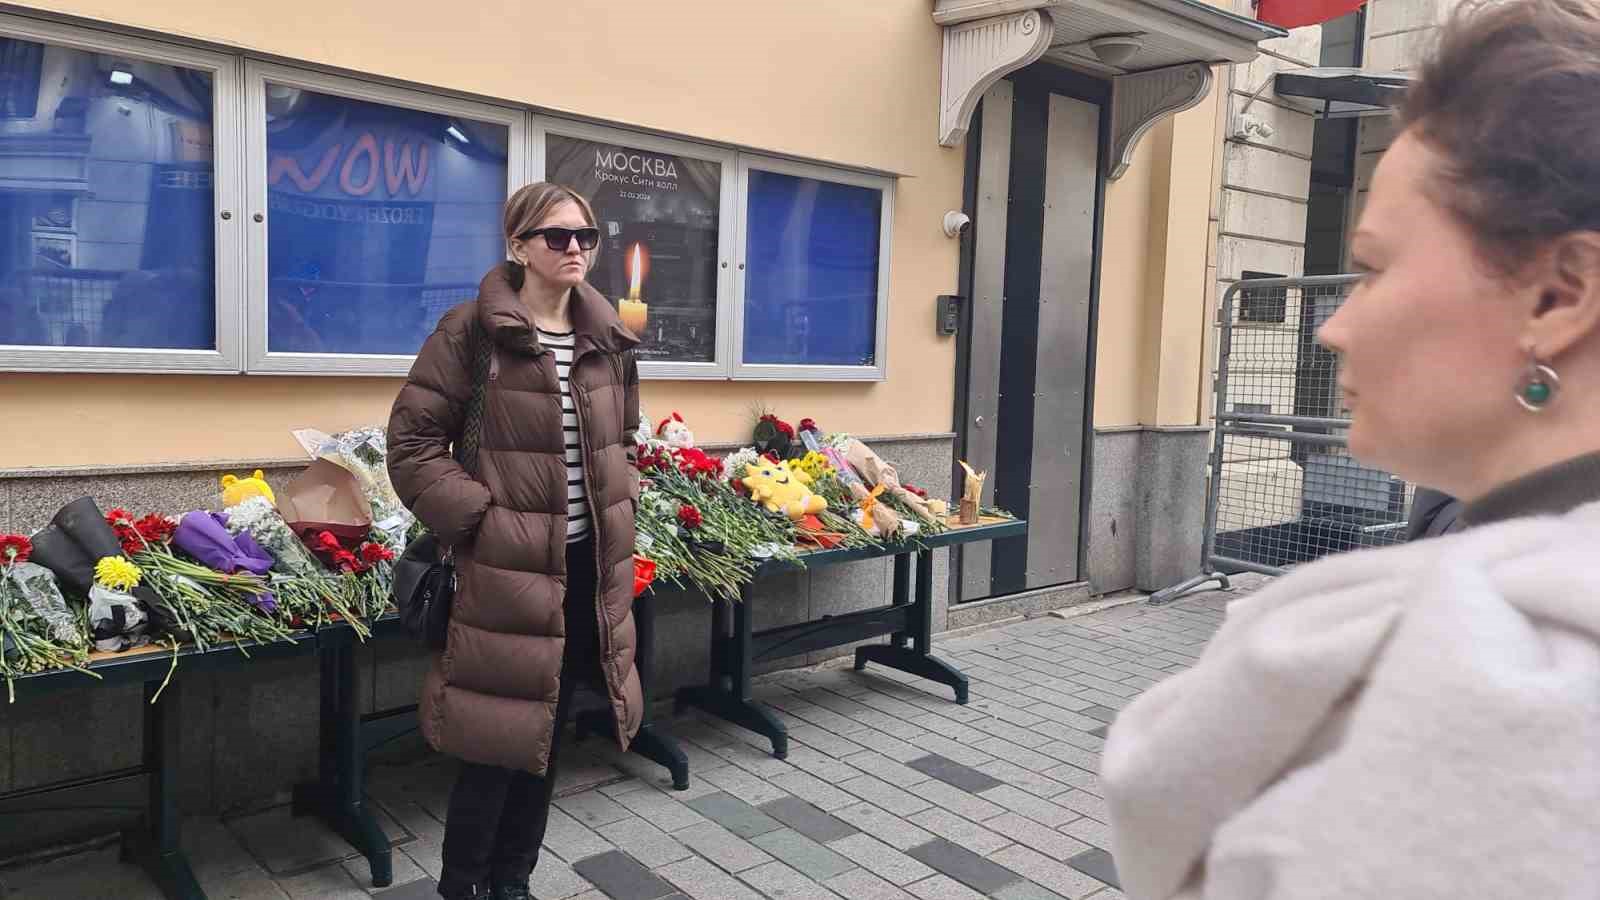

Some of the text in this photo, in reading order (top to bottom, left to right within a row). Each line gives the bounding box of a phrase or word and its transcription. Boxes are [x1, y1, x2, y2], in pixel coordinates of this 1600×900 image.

[595, 149, 678, 179] МОСКВА
[594, 168, 630, 185] Крокус
[631, 174, 655, 188] Сити
